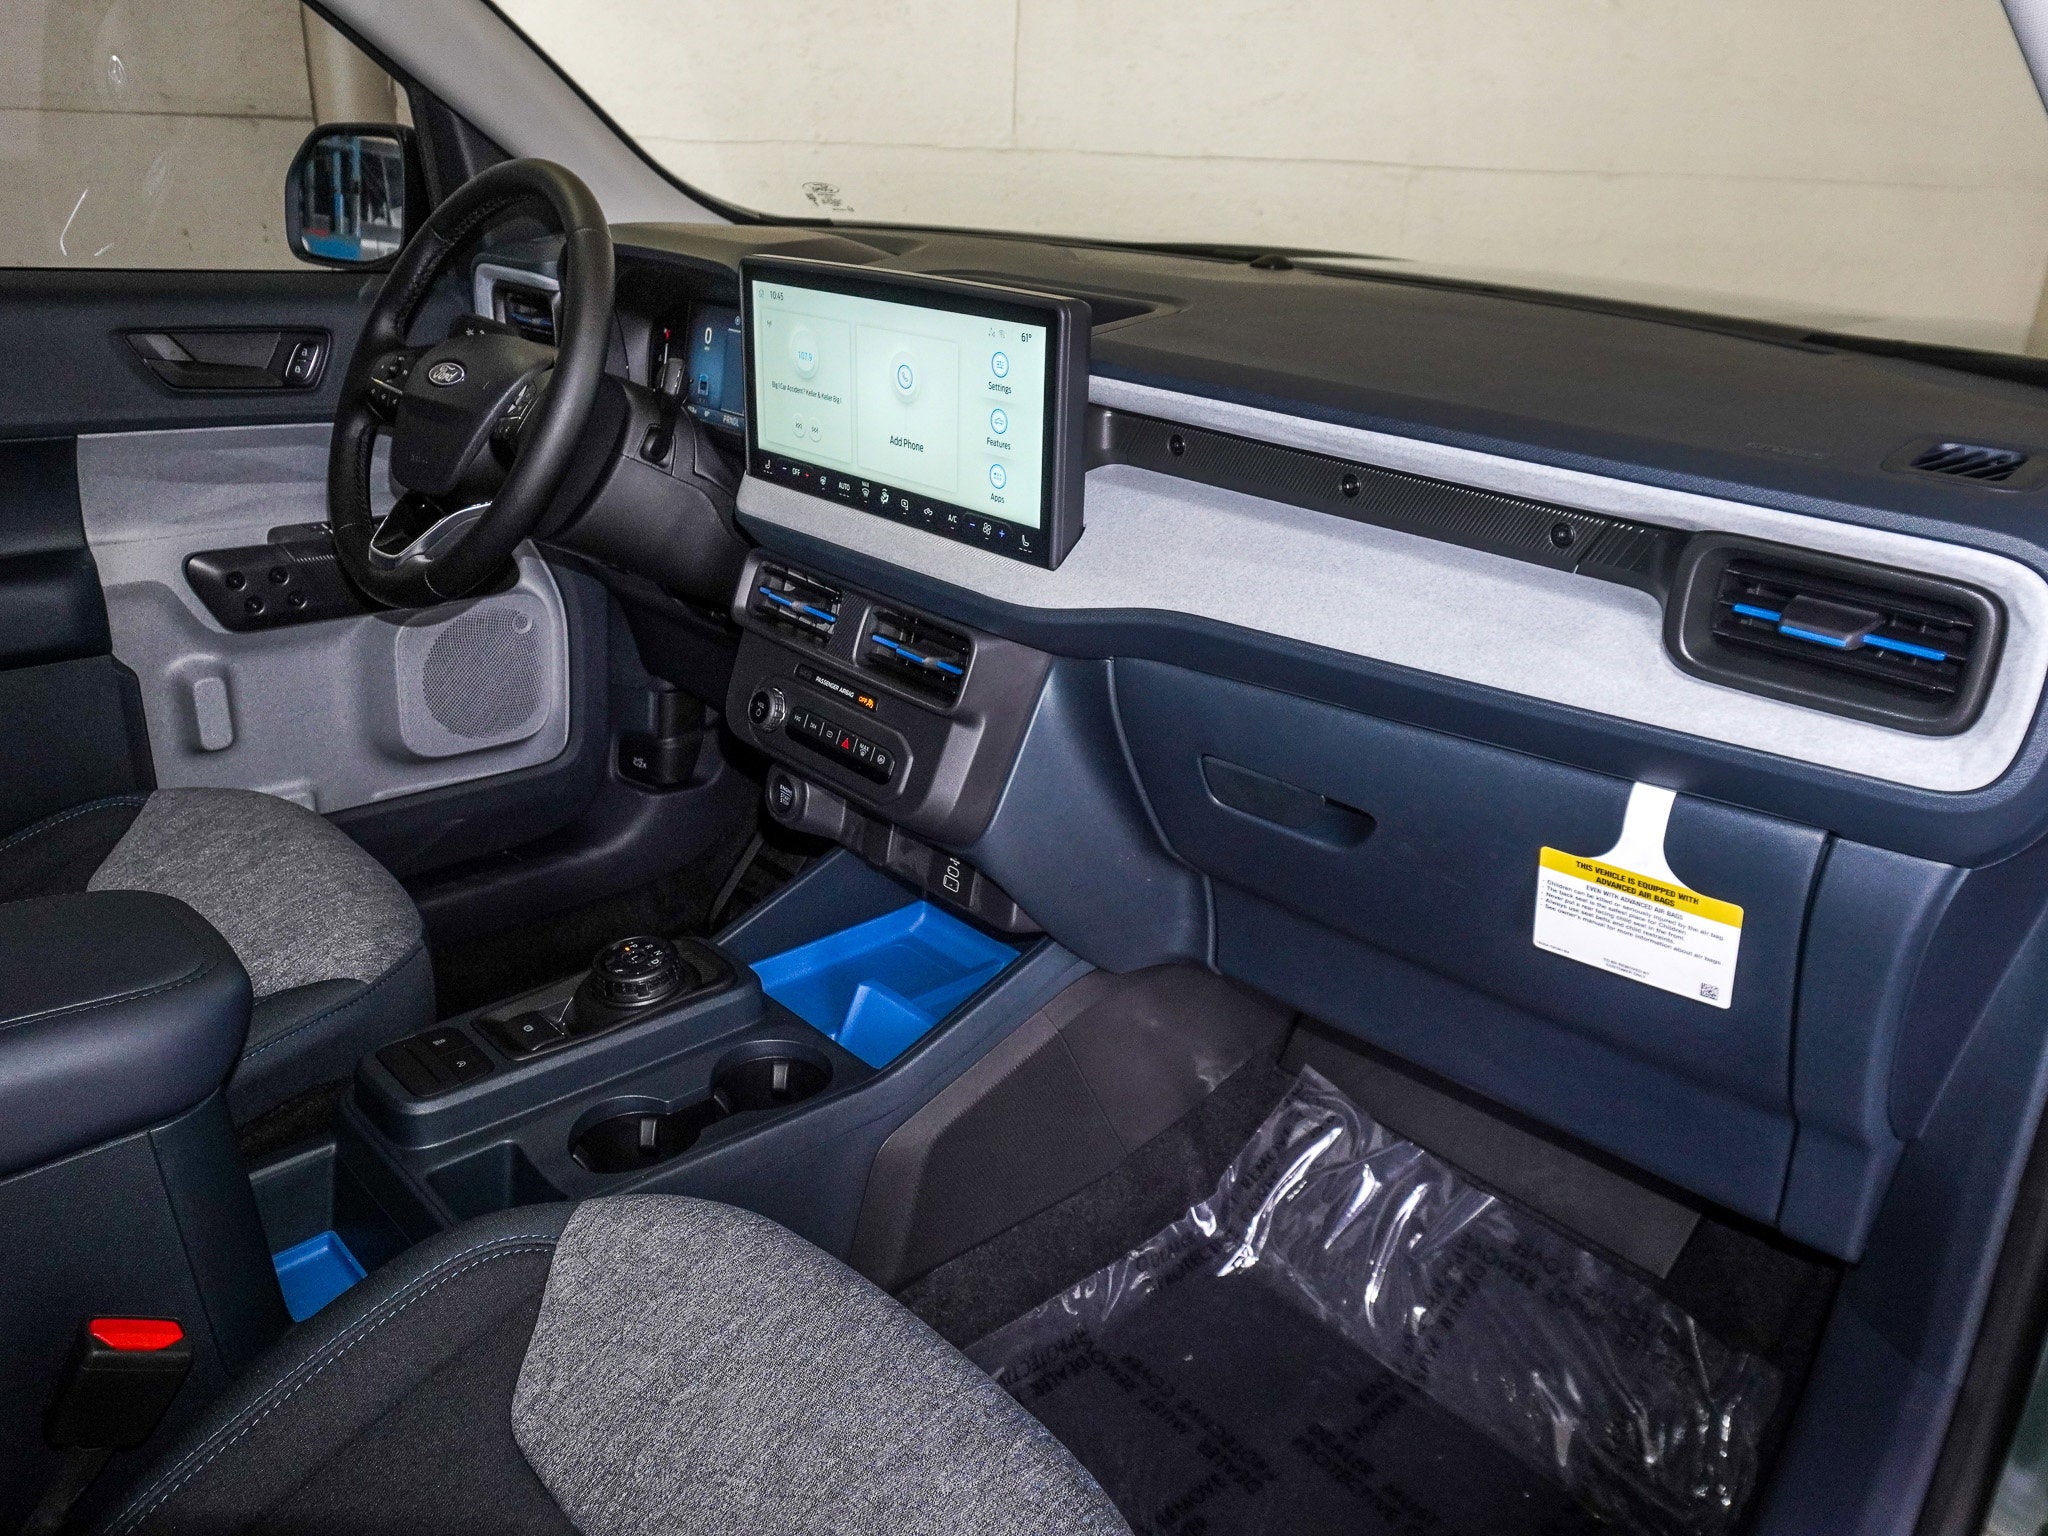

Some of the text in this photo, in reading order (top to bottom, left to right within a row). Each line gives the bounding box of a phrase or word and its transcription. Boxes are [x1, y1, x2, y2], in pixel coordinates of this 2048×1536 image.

[770, 291, 784, 301] 10:45
[705, 327, 712, 345] 0
[1021, 332, 1033, 343] 61°
[798, 351, 813, 362] 107.9
[988, 381, 1012, 394] Settings
[889, 435, 924, 452] Add Phone
[986, 437, 1011, 450] Features
[792, 468, 801, 476] OFF
[838, 482, 851, 492] AUTO
[990, 493, 1005, 504] Apps
[948, 514, 958, 524] A/C
[815, 676, 854, 698] PASSENGER AIRBAG
[858, 696, 868, 704] OFF
[859, 743, 870, 752] MAX
[1575, 860, 1698, 904] THIS VEHICLE IS EQUIPPED WITH
[1596, 876, 1674, 906] ADVANCED AIR BAGS
[1547, 880, 1571, 892] Children
[1573, 888, 1584, 896] can
[1595, 895, 1611, 905] killed
[1622, 904, 1651, 917] seriously
[1653, 914, 1676, 925] injured
[1688, 924, 1698, 932] the
[1700, 928, 1709, 936] air
[1559, 890, 1572, 898] back
[1575, 895, 1587, 903] seat
[1596, 901, 1606, 909] the
[1608, 905, 1627, 915] safest
[1628, 911, 1645, 921] place
[1647, 917, 1656, 925] for
[1586, 884, 1683, 920] EVEN WITH ADVANCED AIR BAGS
[1545, 898, 1567, 909] Always
[1568, 905, 1578, 913] use
[1581, 909, 1593, 918] seat
[1612, 919, 1624, 927] and
[1625, 924, 1641, 933] child
[1546, 892, 1563, 902] Never
[1582, 903, 1593, 911] rear
[1595, 907, 1614, 918] facing
[1616, 914, 1631, 923] child
[1633, 920, 1646, 928] seat
[1656, 927, 1666, 935] the
[1545, 903, 1556, 912] See
[1583, 916, 1605, 927] manual
[1606, 923, 1615, 931] for
[1617, 927, 1633, 937] more
[1635, 932, 1671, 949] information
[1673, 945, 1692, 956] about
